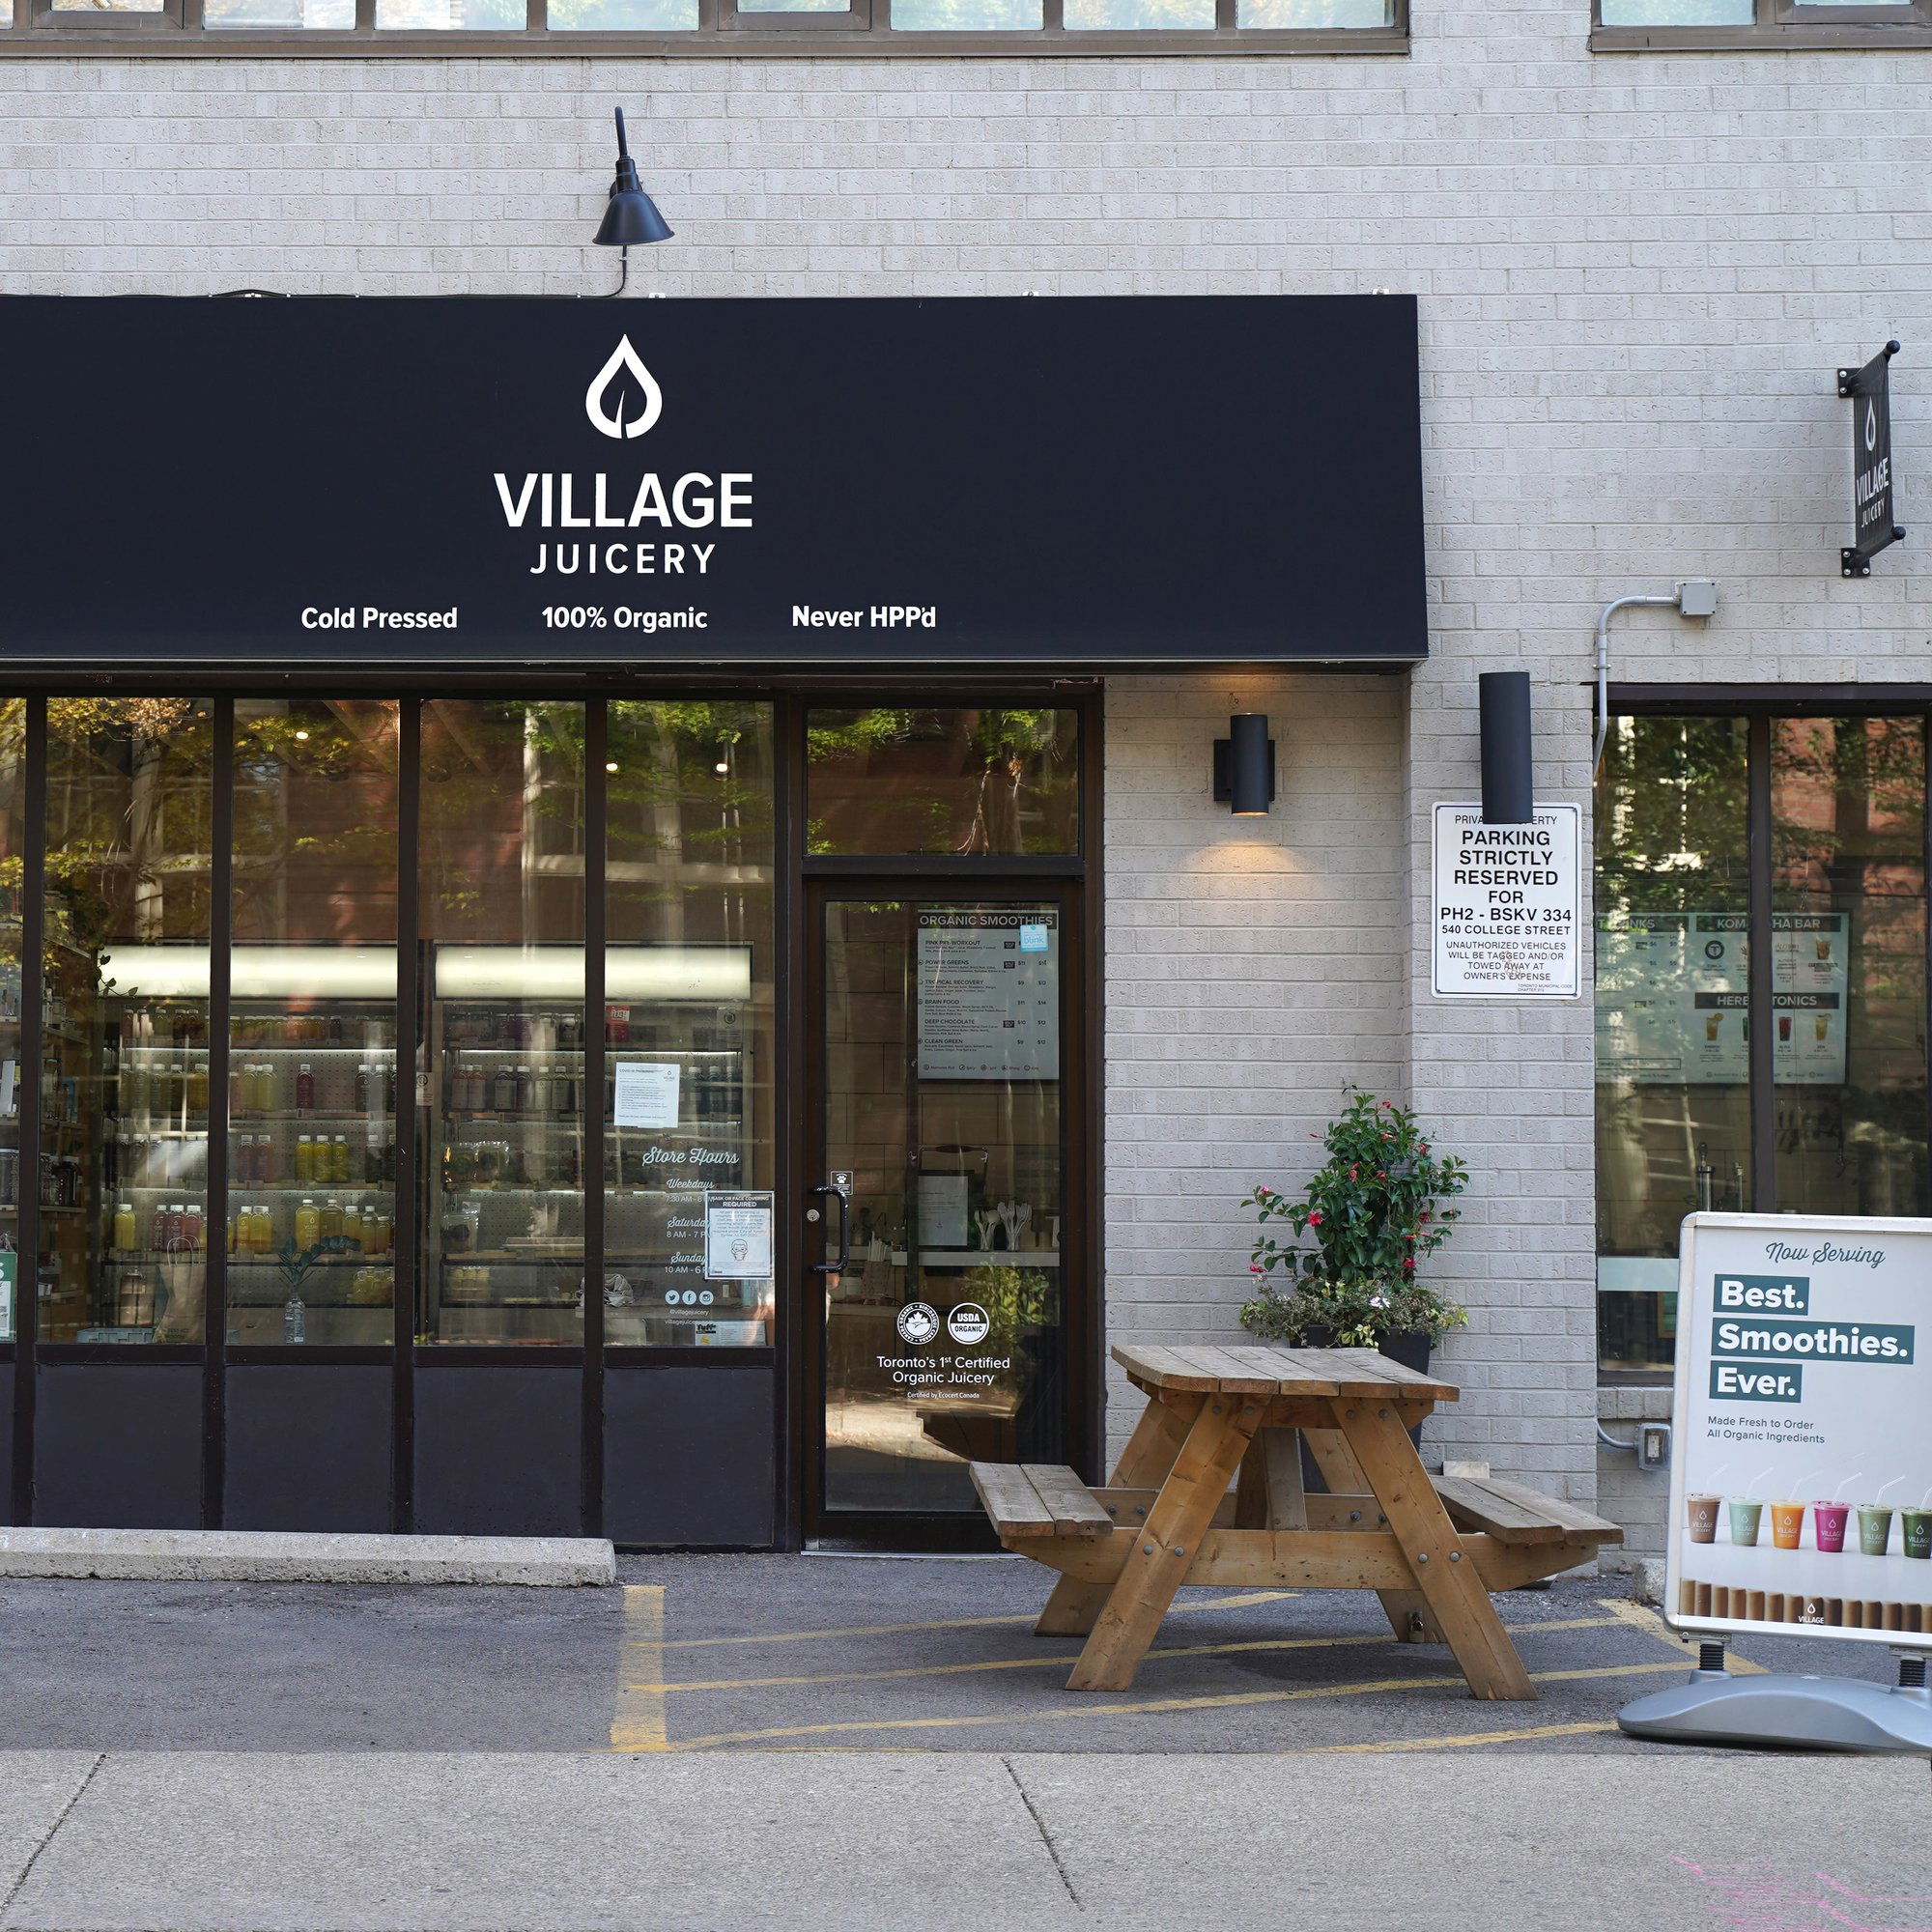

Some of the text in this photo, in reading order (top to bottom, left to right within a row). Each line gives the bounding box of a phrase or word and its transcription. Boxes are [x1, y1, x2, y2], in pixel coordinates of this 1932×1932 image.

[1856, 457, 1889, 506] VILLAGE
[494, 472, 753, 528] VILLAGE
[1861, 497, 1886, 528] JUICERY
[529, 543, 716, 575] JUICERY
[300, 607, 458, 631] Cold Pressed
[541, 606, 708, 635] 100% Organic
[791, 605, 936, 629] Never HPP'd
[1455, 814, 1484, 825] PRIVA
[1462, 830, 1550, 846] PARKING
[1459, 850, 1553, 866] STRICTLY
[1454, 870, 1559, 886] RESERVED
[1489, 891, 1524, 904] FOR
[920, 915, 1054, 926] ORGANIC SMOOTHIES
[1440, 907, 1474, 921] PH2
[1491, 908, 1537, 922] BSKV
[1543, 908, 1572, 922] 334
[1441, 924, 1571, 936] 540 COLLEGE STREET
[1717, 919, 1822, 929] KOMHA BAR
[1446, 941, 1567, 951] UNAUTHORIZED VEHICLES
[1487, 952, 1526, 960] TAGGED
[1467, 961, 1502, 970] TOWED
[1532, 962, 1545, 971] AT
[1463, 972, 1551, 981] OWNER'S EXPENSE
[641, 1146, 740, 1167] Store Hours
[666, 1178, 715, 1192] Weekdays
[666, 1230, 672, 1238] 8
[672, 1230, 687, 1238] AM
[1765, 1241, 1886, 1269] Now Serving
[674, 1265, 689, 1274] AM
[695, 1265, 701, 1274] 6
[1720, 1280, 1804, 1310] Best.
[956, 1313, 980, 1323] USDA
[1717, 1322, 1909, 1358] Smoothies.
[876, 1355, 1010, 1369] Toronto's 1st Certified
[893, 1371, 995, 1386] Organic Juicery
[1717, 1366, 1797, 1397] Ever.
[1707, 1415, 1814, 1430] Made Fresh to Order
[1707, 1429, 1826, 1444] All Organic Ingredients
[1798, 1615, 1825, 1625] VILLAGE
